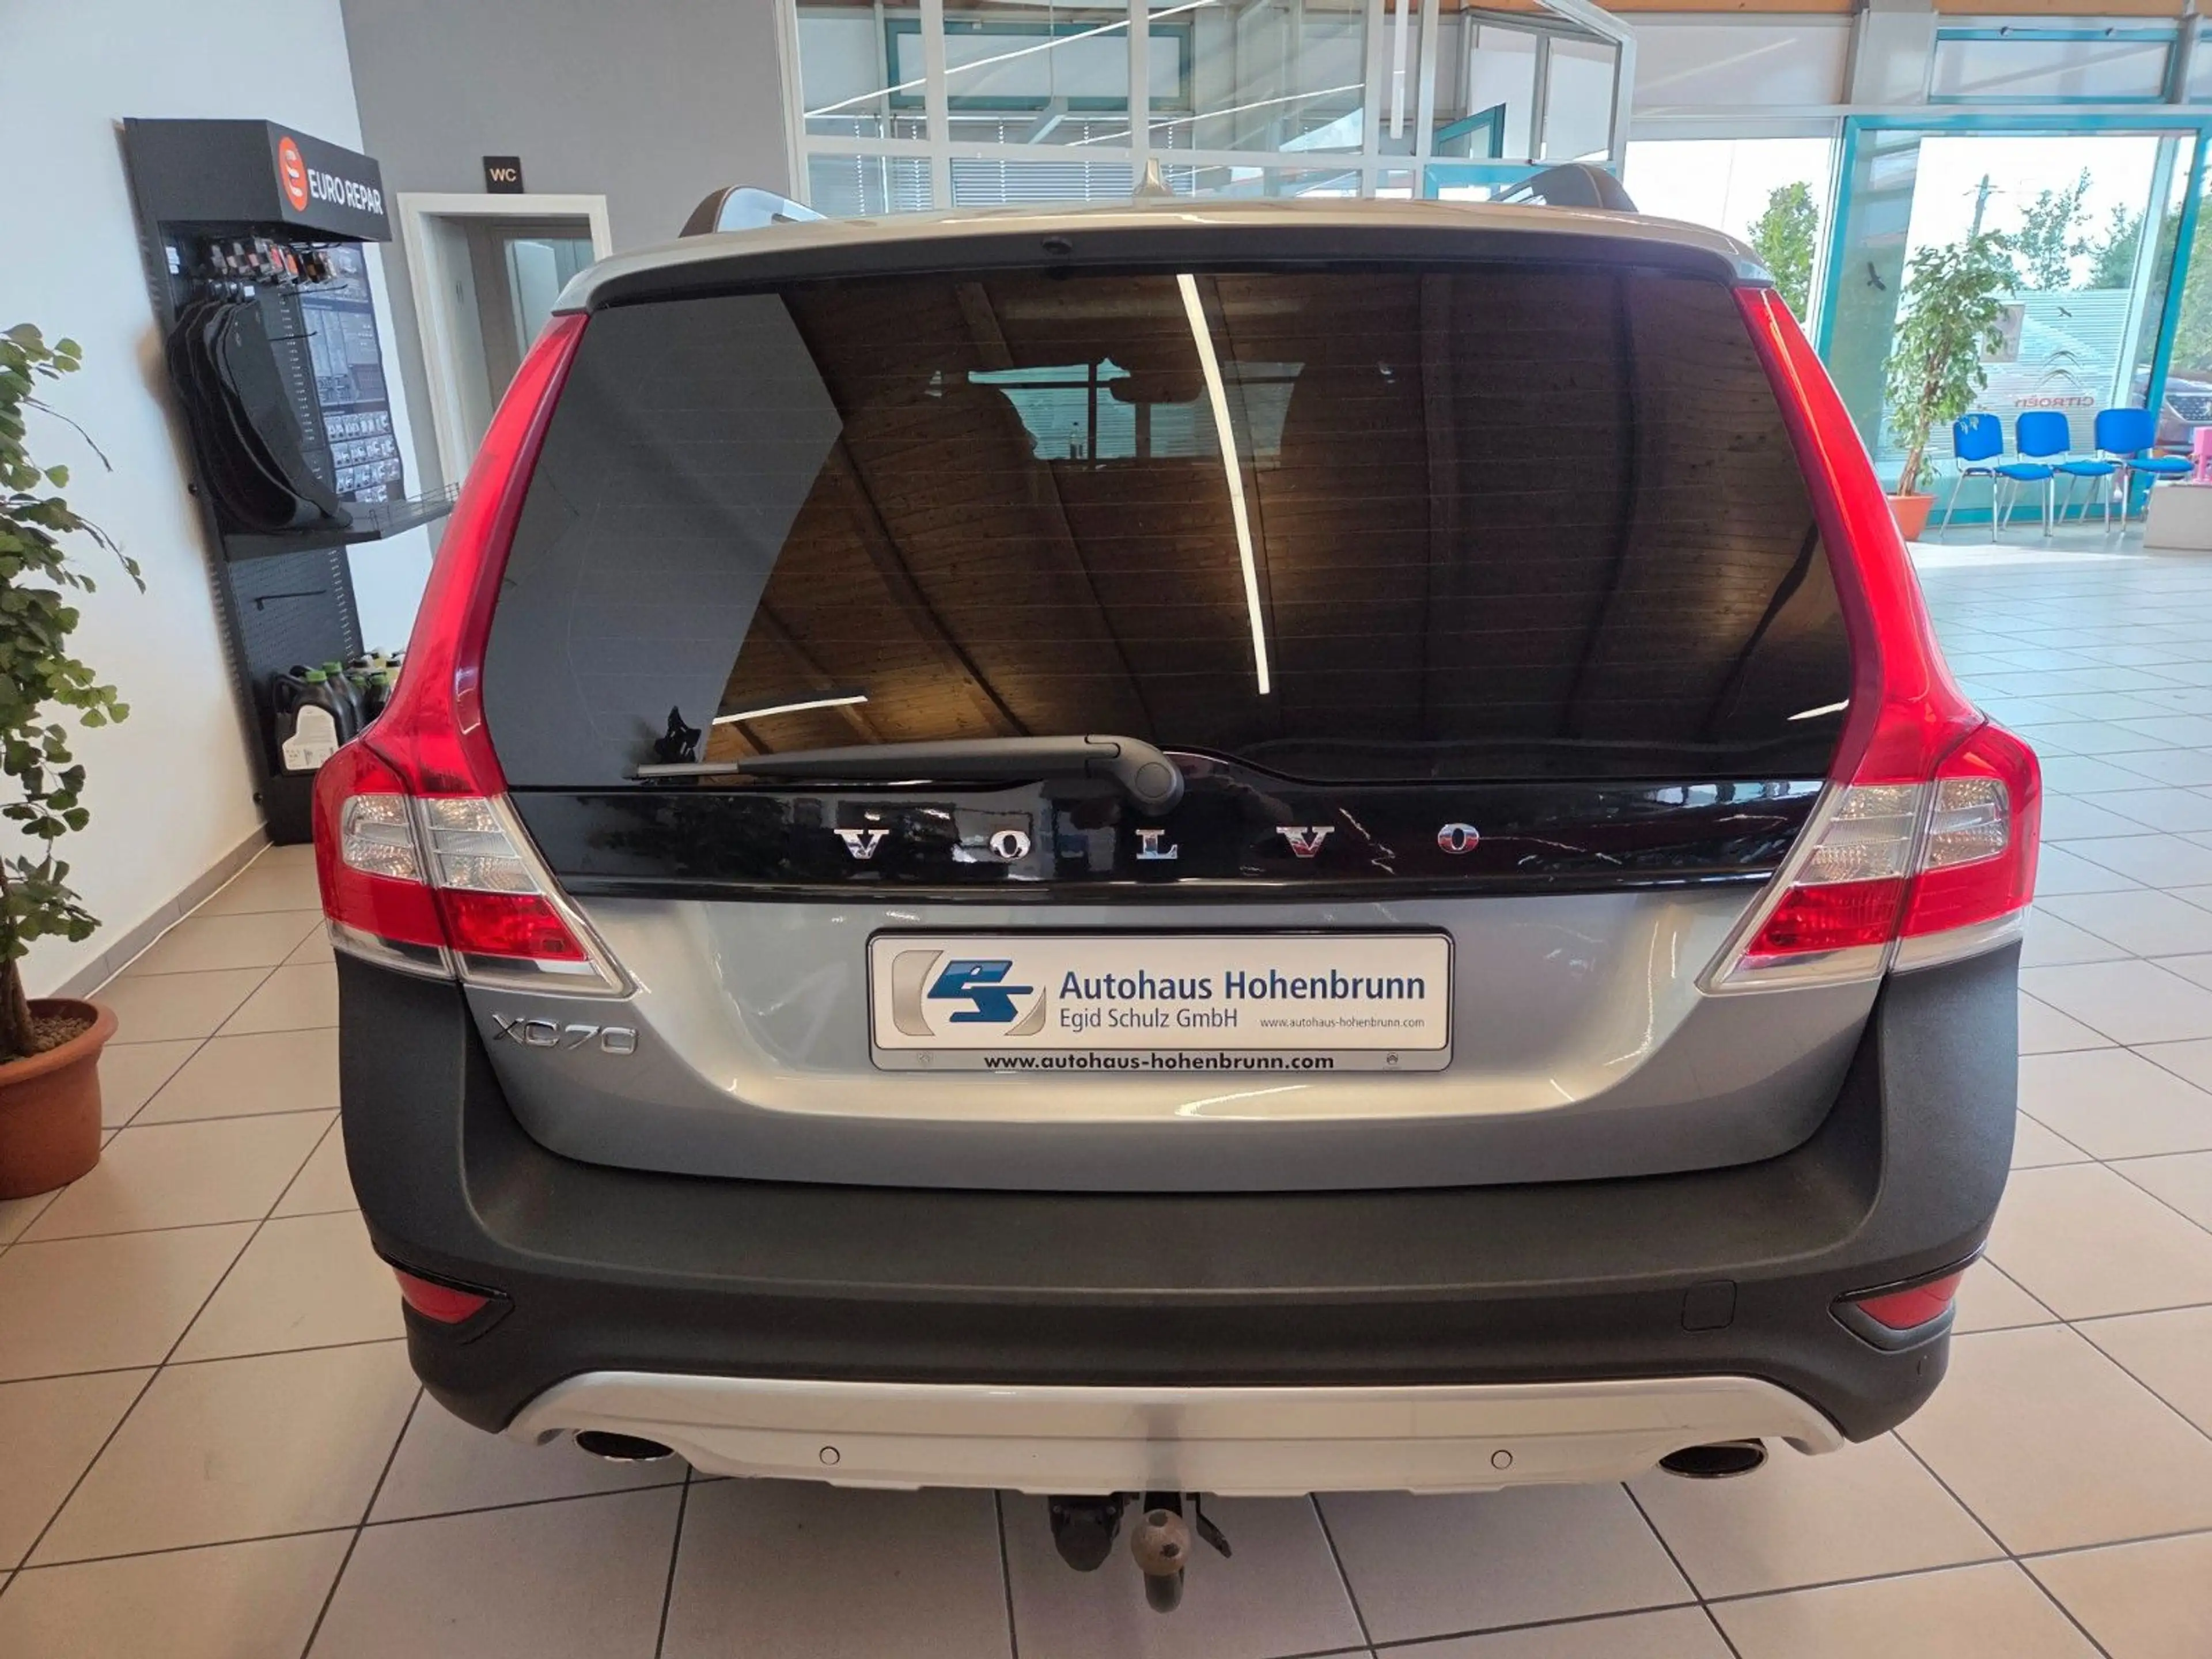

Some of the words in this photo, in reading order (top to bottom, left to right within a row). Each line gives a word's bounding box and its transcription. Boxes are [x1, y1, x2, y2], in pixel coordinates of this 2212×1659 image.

[489, 168, 517, 182] WC
[308, 168, 346, 205] EURO
[344, 180, 384, 215] REPAR
[833, 823, 1480, 861] VOLVO
[1059, 969, 1213, 999] Autohaus
[1225, 969, 1426, 999] Hohenbrunn
[1060, 1007, 1101, 1032] Egid
[1108, 1007, 1169, 1028] Schulz
[1176, 1007, 1238, 1028] GmbH
[1260, 1017, 1426, 1028] www.autohaus-hohenbrunn.com
[492, 1014, 638, 1054] XC70
[984, 1052, 1335, 1070] www.autohaus-hohenbrunn.com
